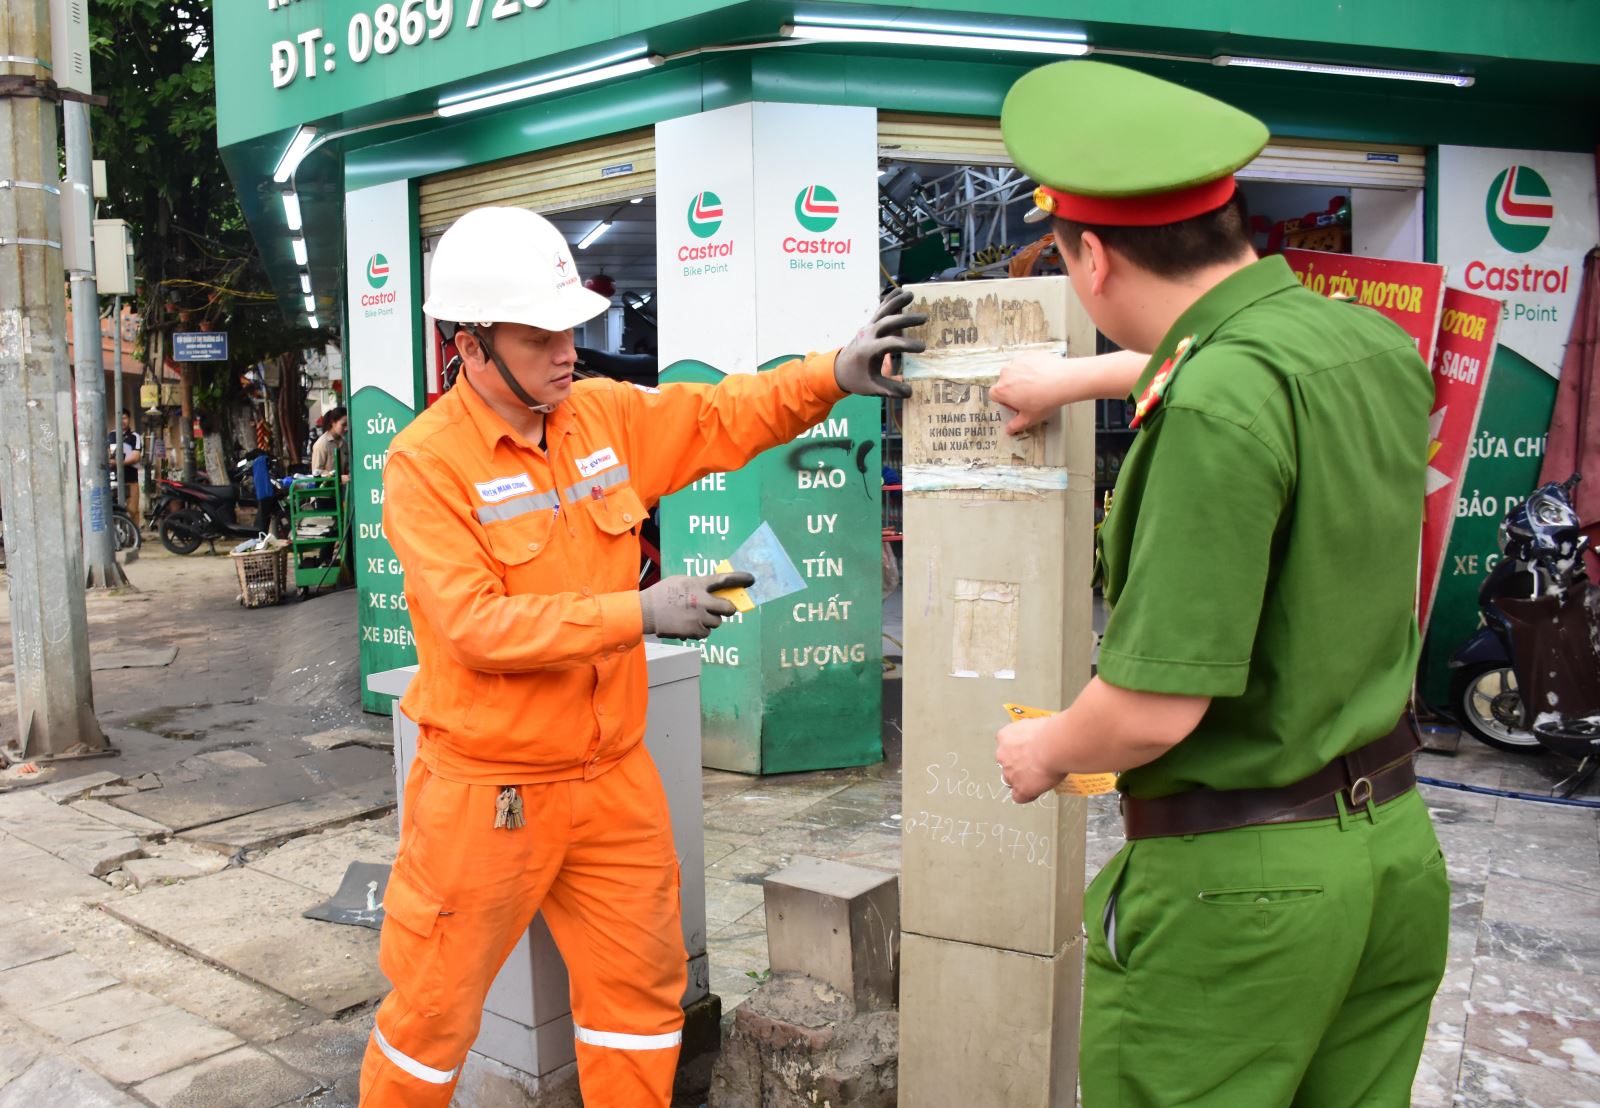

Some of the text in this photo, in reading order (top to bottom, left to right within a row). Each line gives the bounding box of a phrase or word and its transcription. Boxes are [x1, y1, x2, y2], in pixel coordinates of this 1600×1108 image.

[270, 27, 336, 88] ĐT:
[348, 0, 453, 62] 0869
[678, 240, 733, 261] Castrol
[782, 237, 851, 254] Castrol
[683, 263, 728, 277] Bike Point
[789, 259, 845, 270] Bike Point
[1464, 260, 1569, 293] Castrol
[361, 290, 396, 306] Castrol
[1359, 280, 1423, 313] MOTOR
[1514, 304, 1557, 321] Point
[1442, 308, 1487, 342] OTOR
[1440, 350, 1480, 385] SẠCH
[367, 412, 397, 434] SỬA
[798, 460, 846, 489] BẢO
[1456, 489, 1498, 517] BẢO
[689, 515, 729, 540] PHỤ
[807, 513, 838, 534] UY
[368, 557, 384, 574] XE
[803, 550, 843, 578] TÍN
[1453, 554, 1478, 575] XE
[370, 592, 386, 609] XE
[792, 594, 852, 623] CHẤT
[363, 626, 380, 643] XE
[780, 643, 865, 671] LƯỢNG
